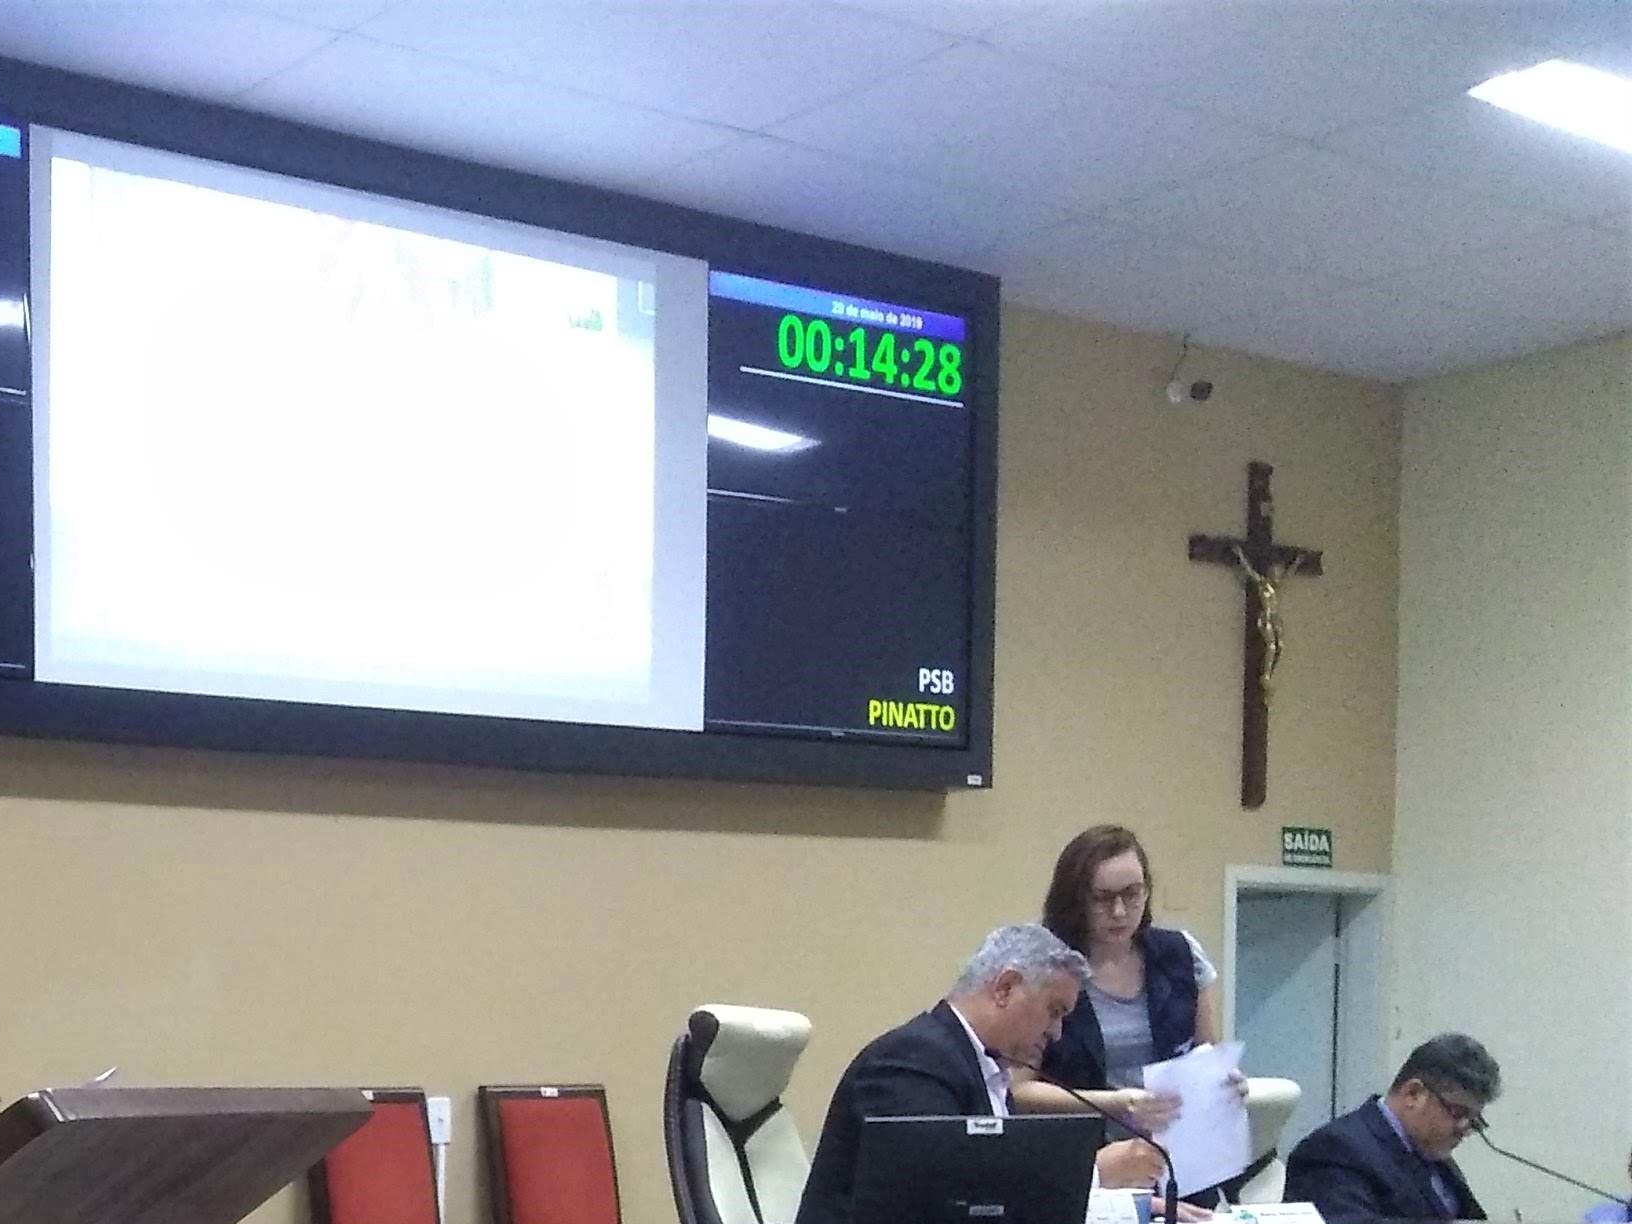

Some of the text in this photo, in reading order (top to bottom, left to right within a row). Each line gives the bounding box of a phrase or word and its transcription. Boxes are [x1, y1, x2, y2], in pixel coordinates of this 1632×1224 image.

[777, 314, 962, 395] 00:14:28
[919, 667, 955, 694] PSB
[868, 699, 956, 731] PINATTO
